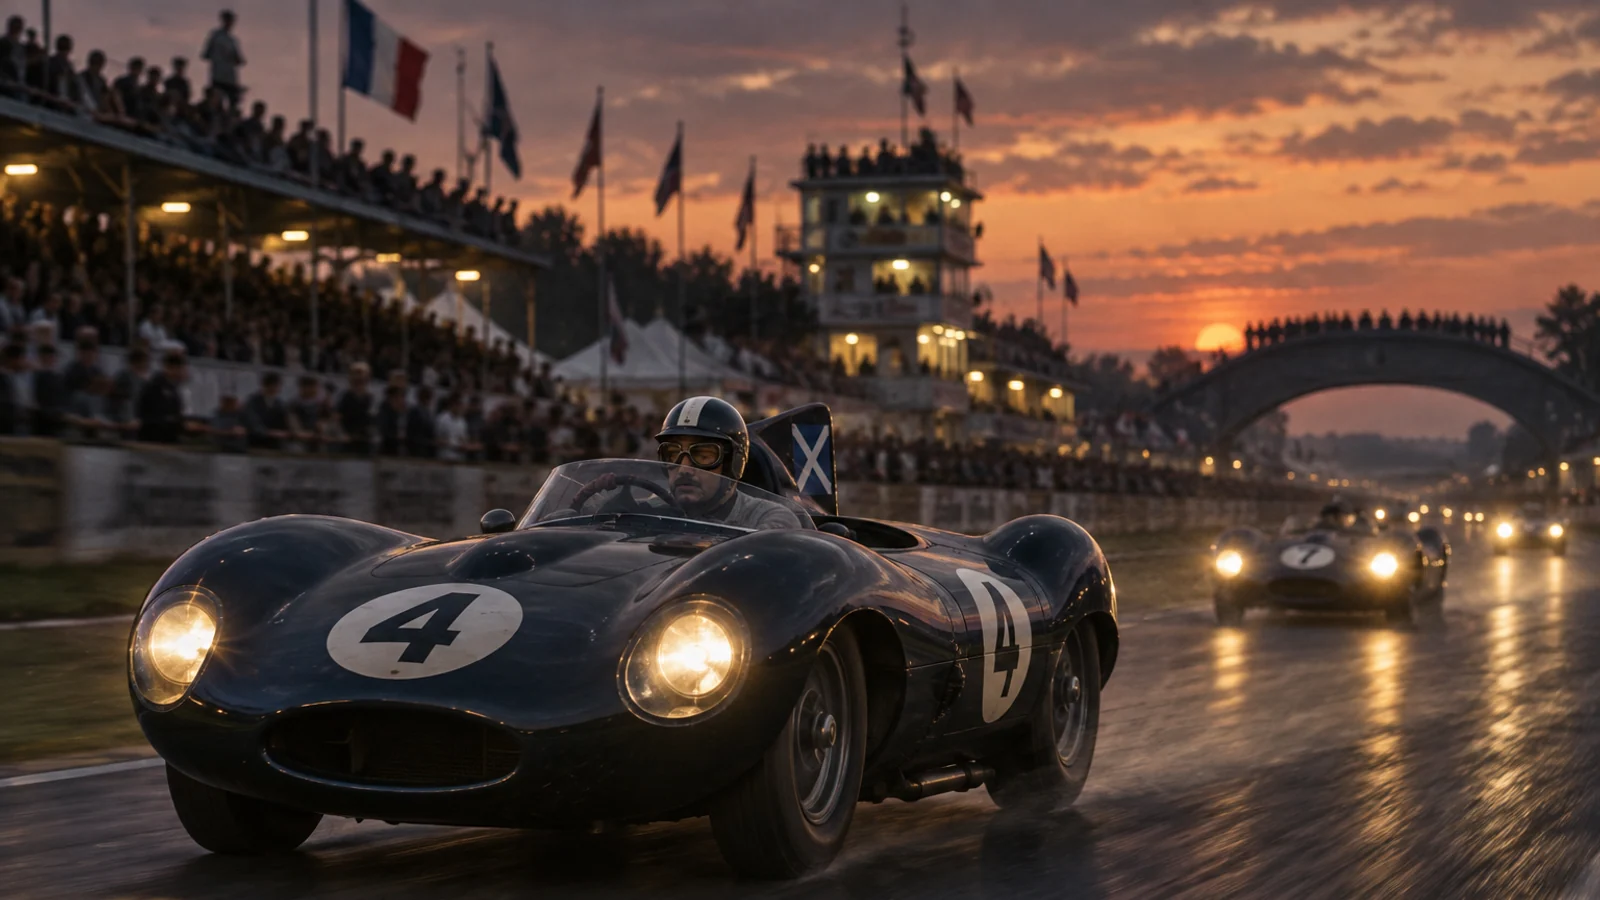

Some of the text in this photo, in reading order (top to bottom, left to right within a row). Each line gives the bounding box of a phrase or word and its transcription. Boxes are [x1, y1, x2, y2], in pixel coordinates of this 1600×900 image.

[1298, 545, 1320, 565] 7
[359, 592, 481, 664] 4
[981, 581, 1020, 698] 4
